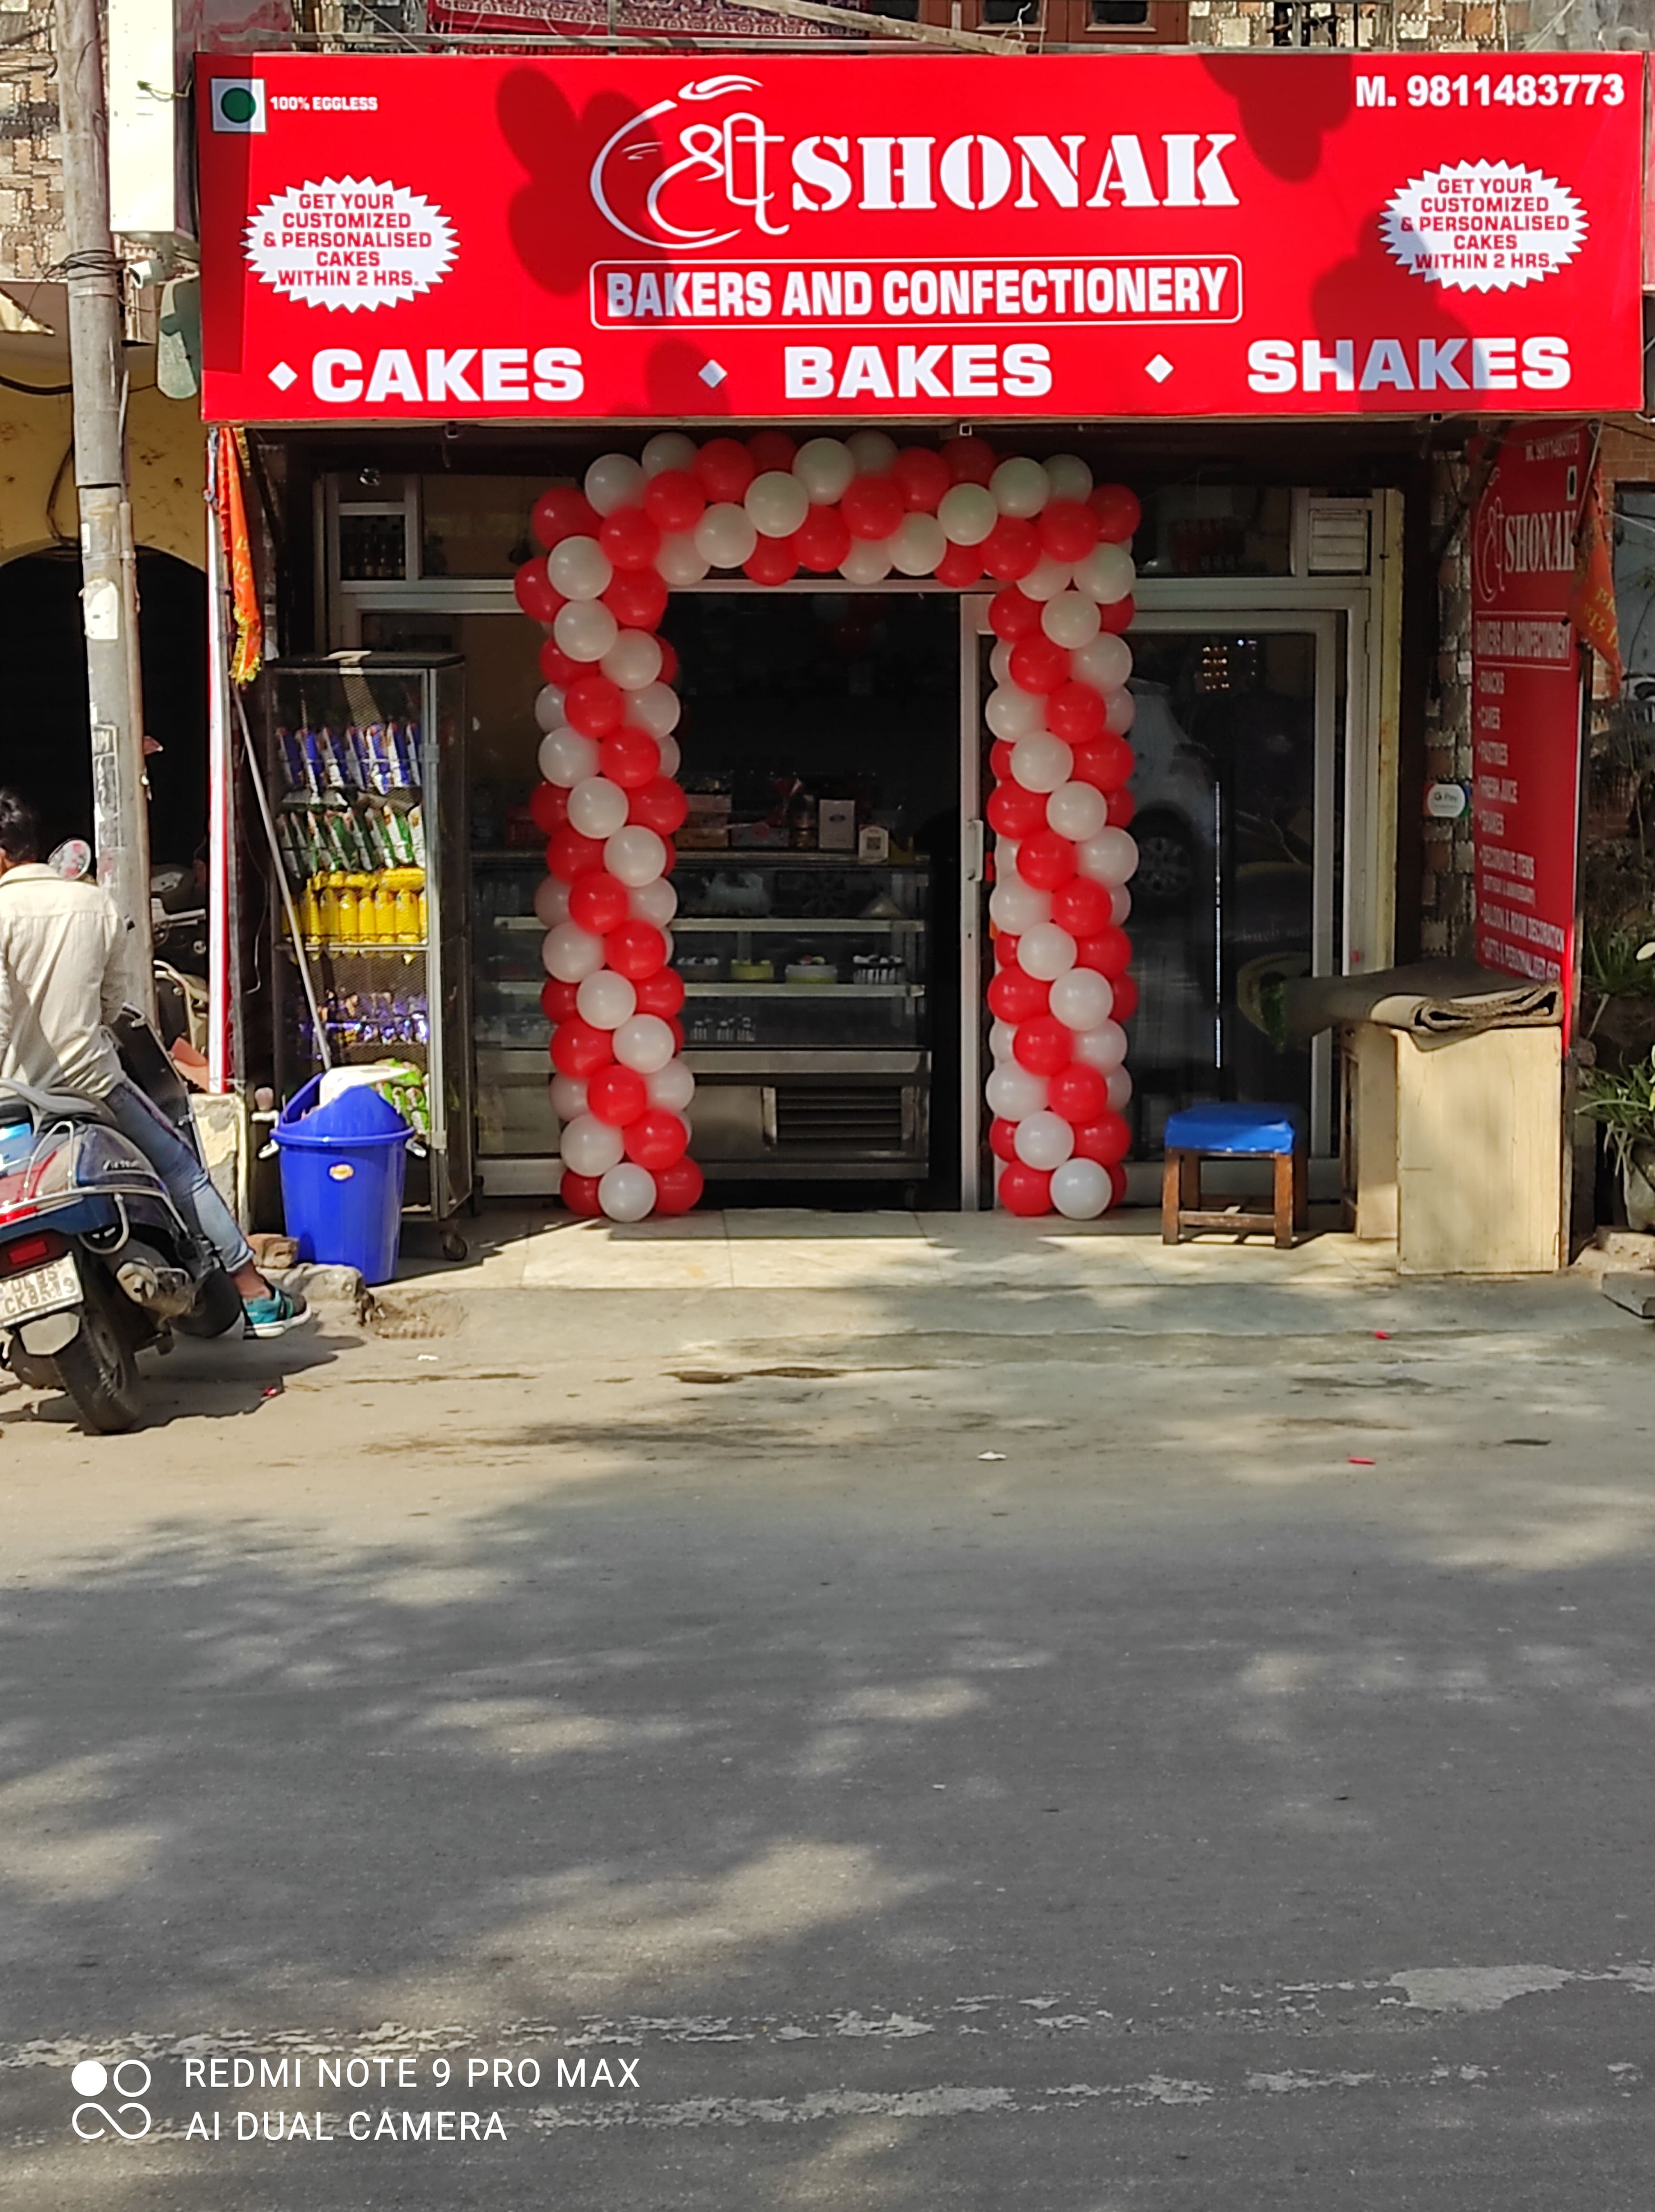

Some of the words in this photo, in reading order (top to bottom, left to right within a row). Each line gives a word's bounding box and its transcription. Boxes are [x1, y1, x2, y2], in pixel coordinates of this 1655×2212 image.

[1356, 75, 1397, 107] M.
[1407, 73, 1625, 107] 9811483773
[270, 96, 310, 111] 100%
[312, 96, 378, 111] EGGLESS
[791, 133, 1240, 212] SHONAK
[1437, 178, 1473, 194] GET
[1480, 178, 1532, 194] YOUR
[299, 193, 336, 210] GET
[341, 193, 394, 210] YOUR
[1421, 197, 1549, 213] CUSTOMIZED
[282, 213, 411, 228] CUSTOMIZED
[1400, 216, 1413, 231] &
[1420, 215, 1569, 231] PERSONALISED
[263, 232, 277, 247] &
[282, 232, 432, 248] PERSONALISED
[1453, 235, 1518, 250] CAKES
[316, 251, 380, 266] CAKES
[1414, 254, 1488, 269] WITHIN
[1494, 254, 1506, 269] 2
[278, 270, 351, 286] WITHIN
[356, 270, 368, 286] 2
[606, 270, 772, 317] BAKERS
[781, 270, 873, 317] AND
[882, 266, 1228, 316] CONFECTIONERY
[784, 343, 1052, 399] BAKES
[1247, 336, 1571, 394] SHAKES
[311, 347, 585, 403] CAKES
